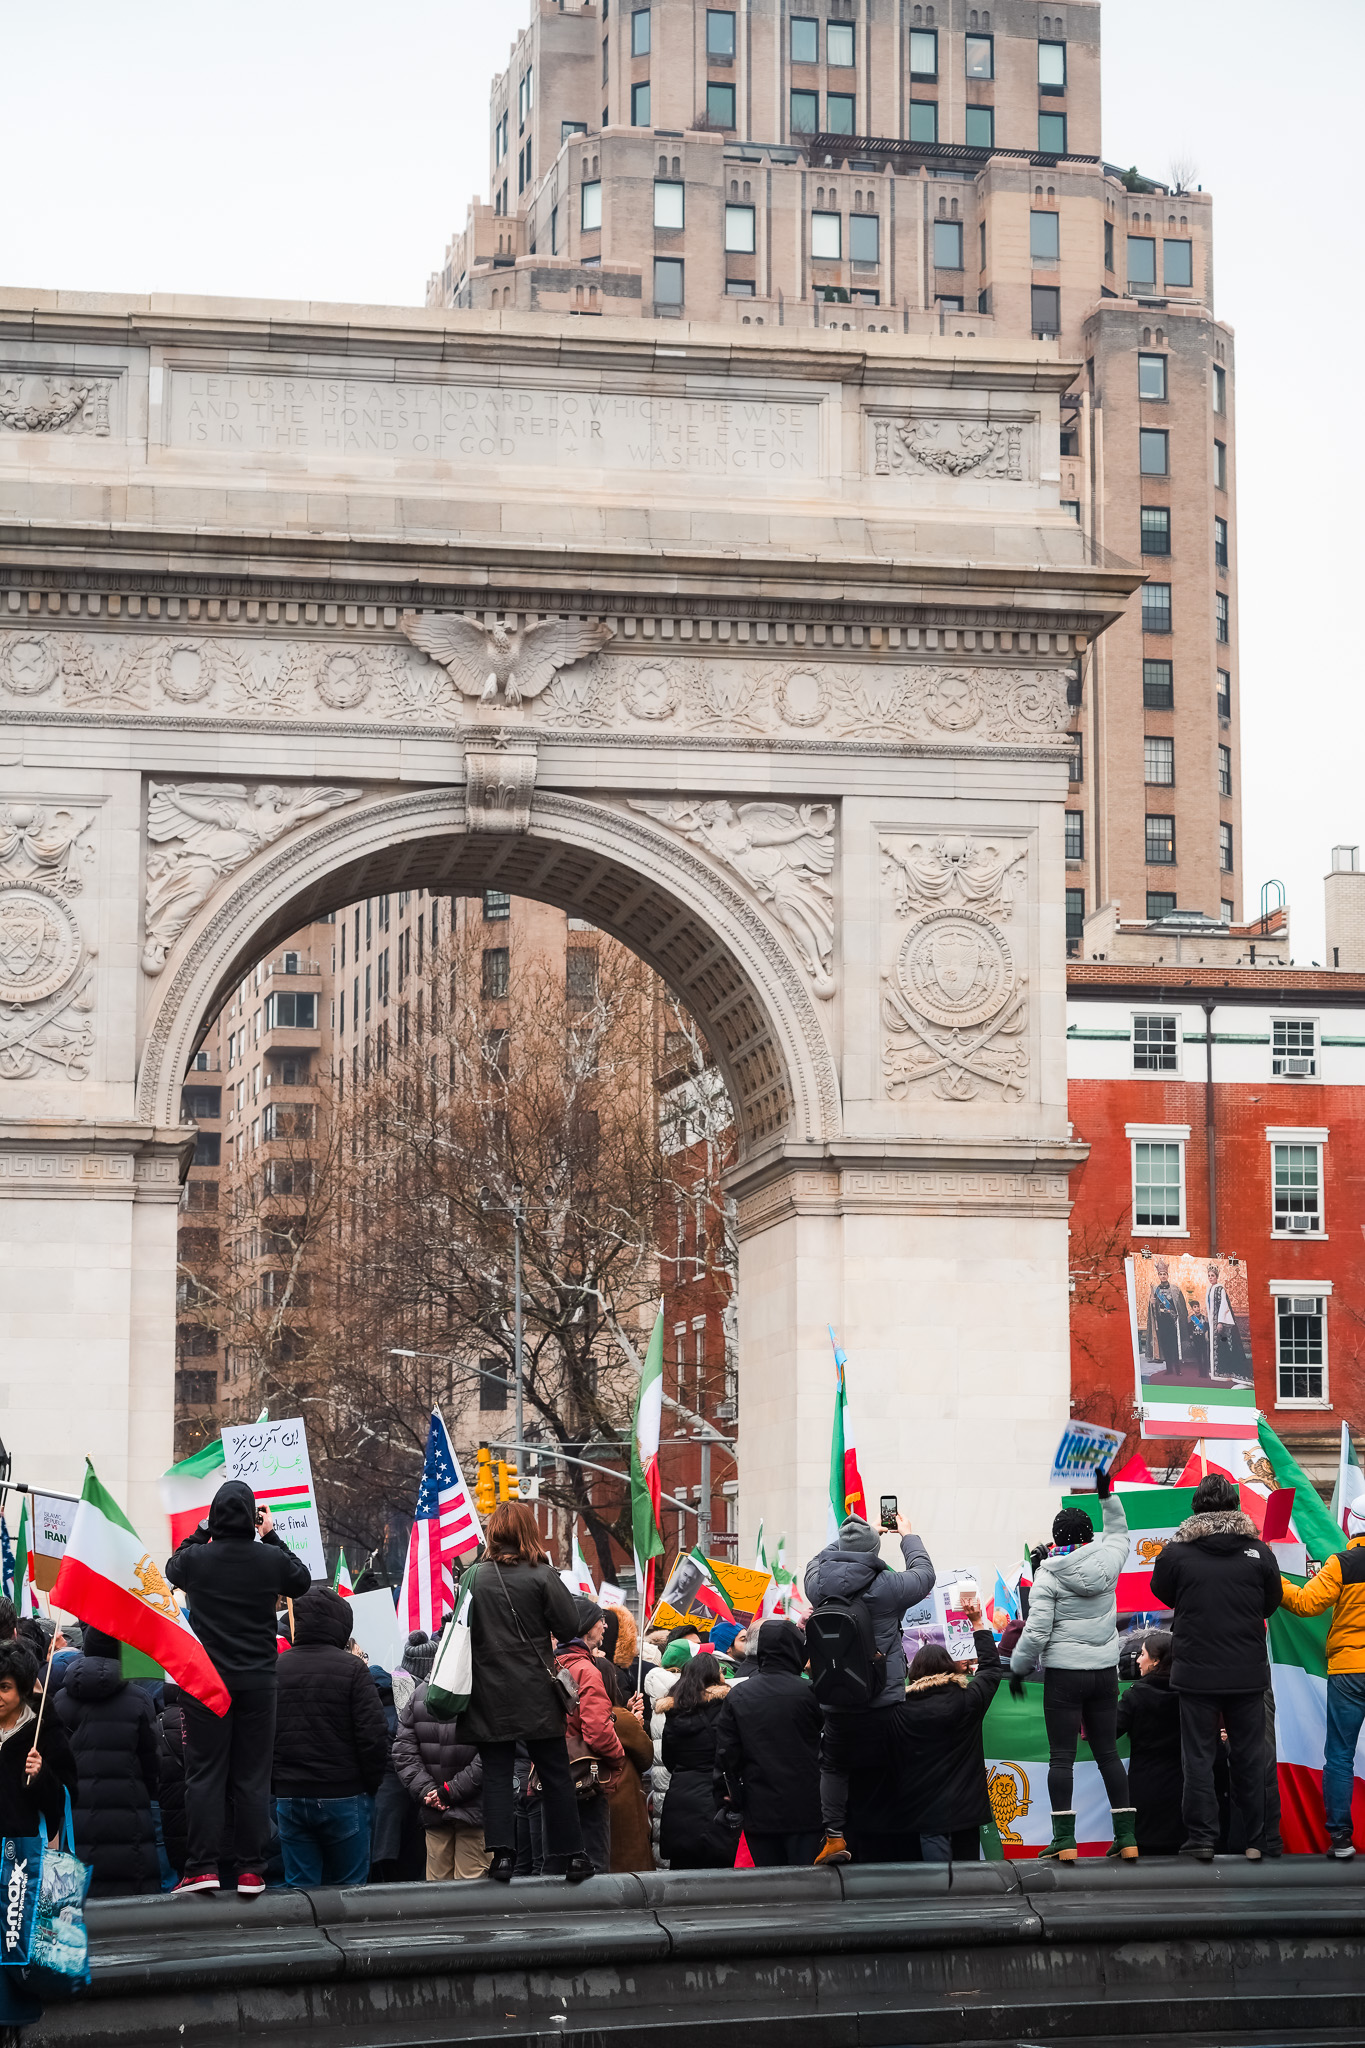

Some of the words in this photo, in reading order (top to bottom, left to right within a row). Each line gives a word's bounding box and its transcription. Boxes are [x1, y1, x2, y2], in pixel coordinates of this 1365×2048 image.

[189, 377, 239, 398] LET
[247, 380, 274, 399] US
[284, 382, 357, 403] RAISE
[366, 387, 384, 406] A
[395, 388, 534, 413] STANDARD
[543, 396, 579, 415] TO
[588, 398, 673, 420] WHICH
[684, 403, 733, 423] THE
[743, 406, 804, 427] WISE
[187, 400, 240, 420] AND
[250, 403, 305, 424] THE
[320, 407, 428, 430] HONEST
[443, 413, 500, 434] CAN
[513, 416, 603, 438] REPAIR
[647, 423, 699, 443] THE
[716, 426, 804, 449] EVENT
[188, 422, 208, 441] IS
[220, 424, 243, 442] IN
[255, 425, 309, 446] THE
[324, 429, 399, 450] HAND
[412, 434, 447, 453] OF
[459, 436, 516, 456] GOD
[627, 444, 804, 469] WASHINGTON
[249, 1425, 282, 1453] آخرین
[281, 1429, 299, 1447] این
[273, 1518, 286, 1531] the
[288, 1515, 309, 1530] final
[44, 1530, 67, 1544] IRAN
[285, 1535, 308, 1550] hlavi
